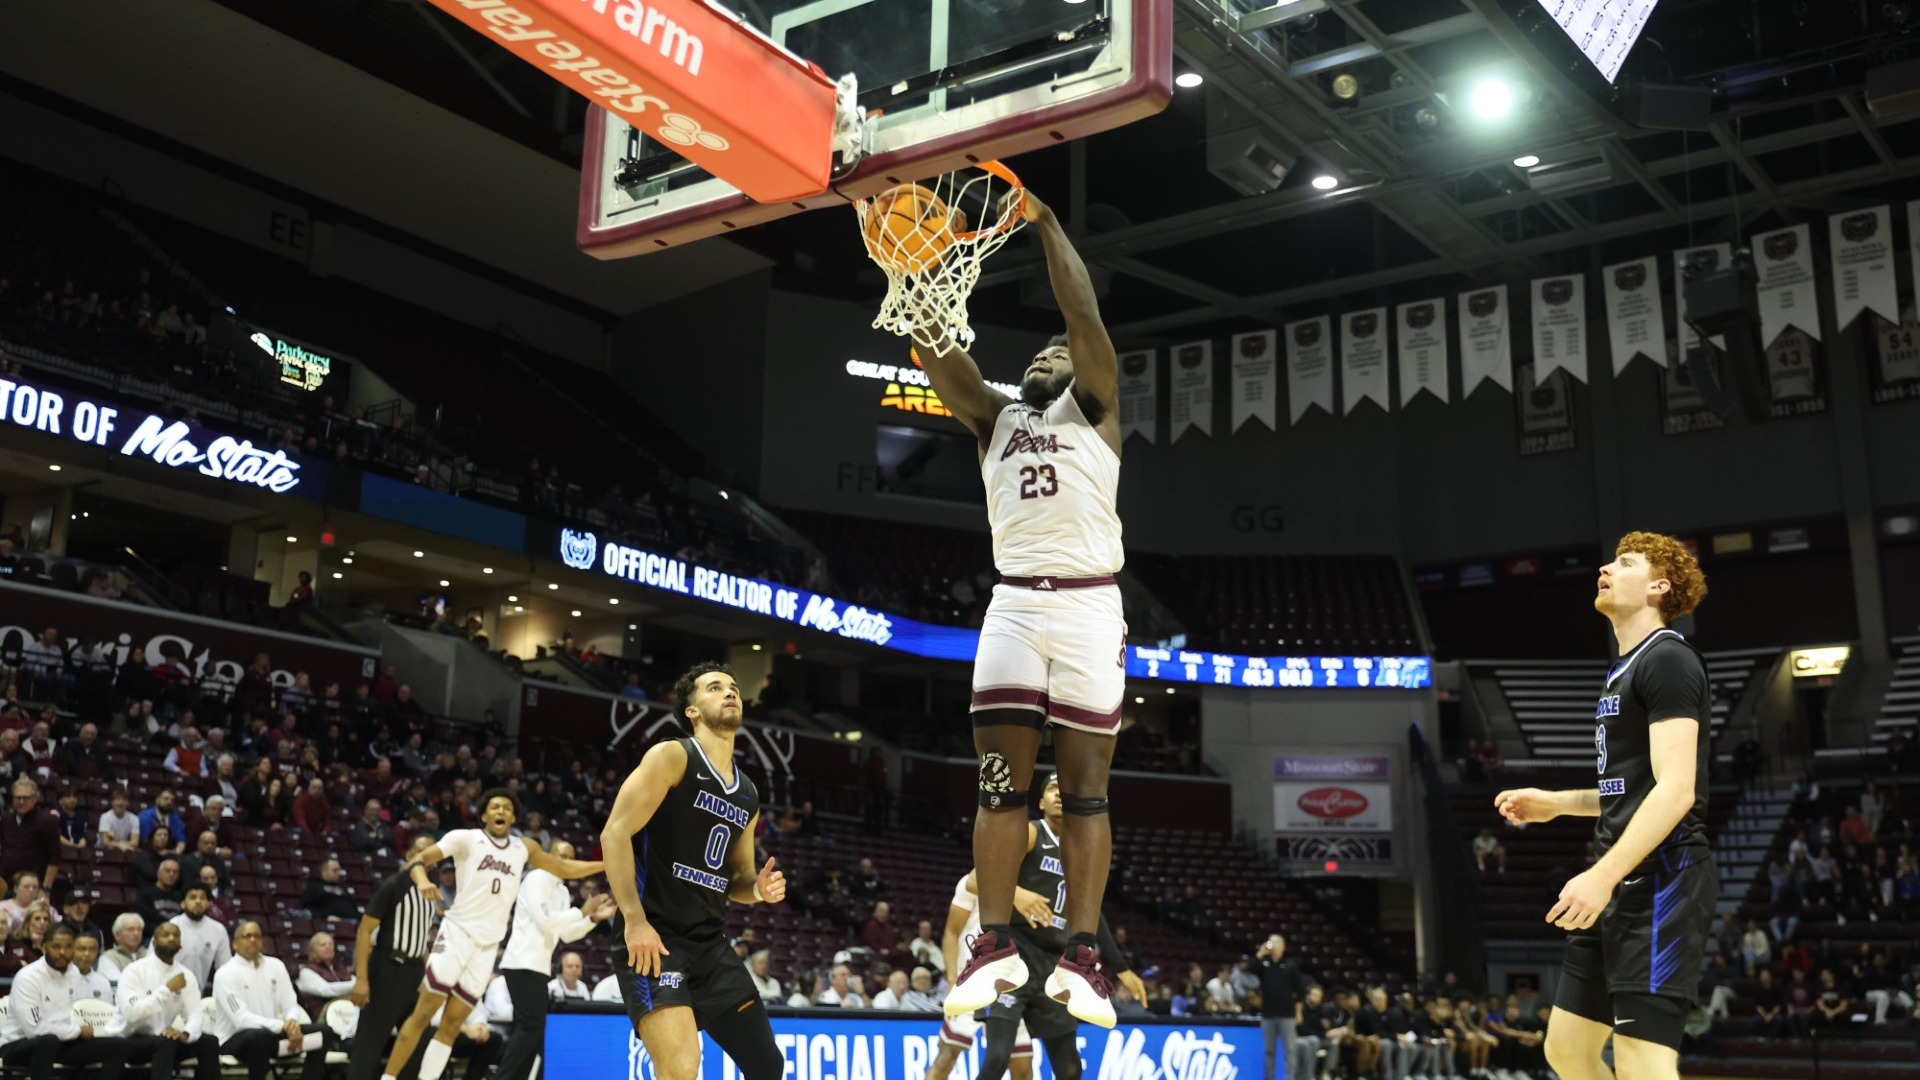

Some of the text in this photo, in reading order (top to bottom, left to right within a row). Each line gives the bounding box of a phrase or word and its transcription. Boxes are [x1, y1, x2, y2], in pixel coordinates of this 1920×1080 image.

[453, 0, 558, 42] Far
[270, 211, 304, 250] EE
[276, 339, 331, 370] Parkcrest
[846, 360, 899, 381] GREAT
[881, 383, 955, 418] ARE
[73, 401, 118, 446] OF
[121, 415, 206, 467] Mo
[199, 436, 300, 493] State
[1000, 428, 1075, 462] Bears
[1019, 463, 1059, 500] 23
[1231, 504, 1284, 535] GG
[603, 542, 893, 646] OFFICIAL REALTOR OF Mo State
[693, 789, 750, 830] MIDDLE
[704, 823, 731, 870] 0
[476, 854, 516, 877] Bears
[491, 877, 502, 895] 0
[1053, 880, 1067, 914] 1
